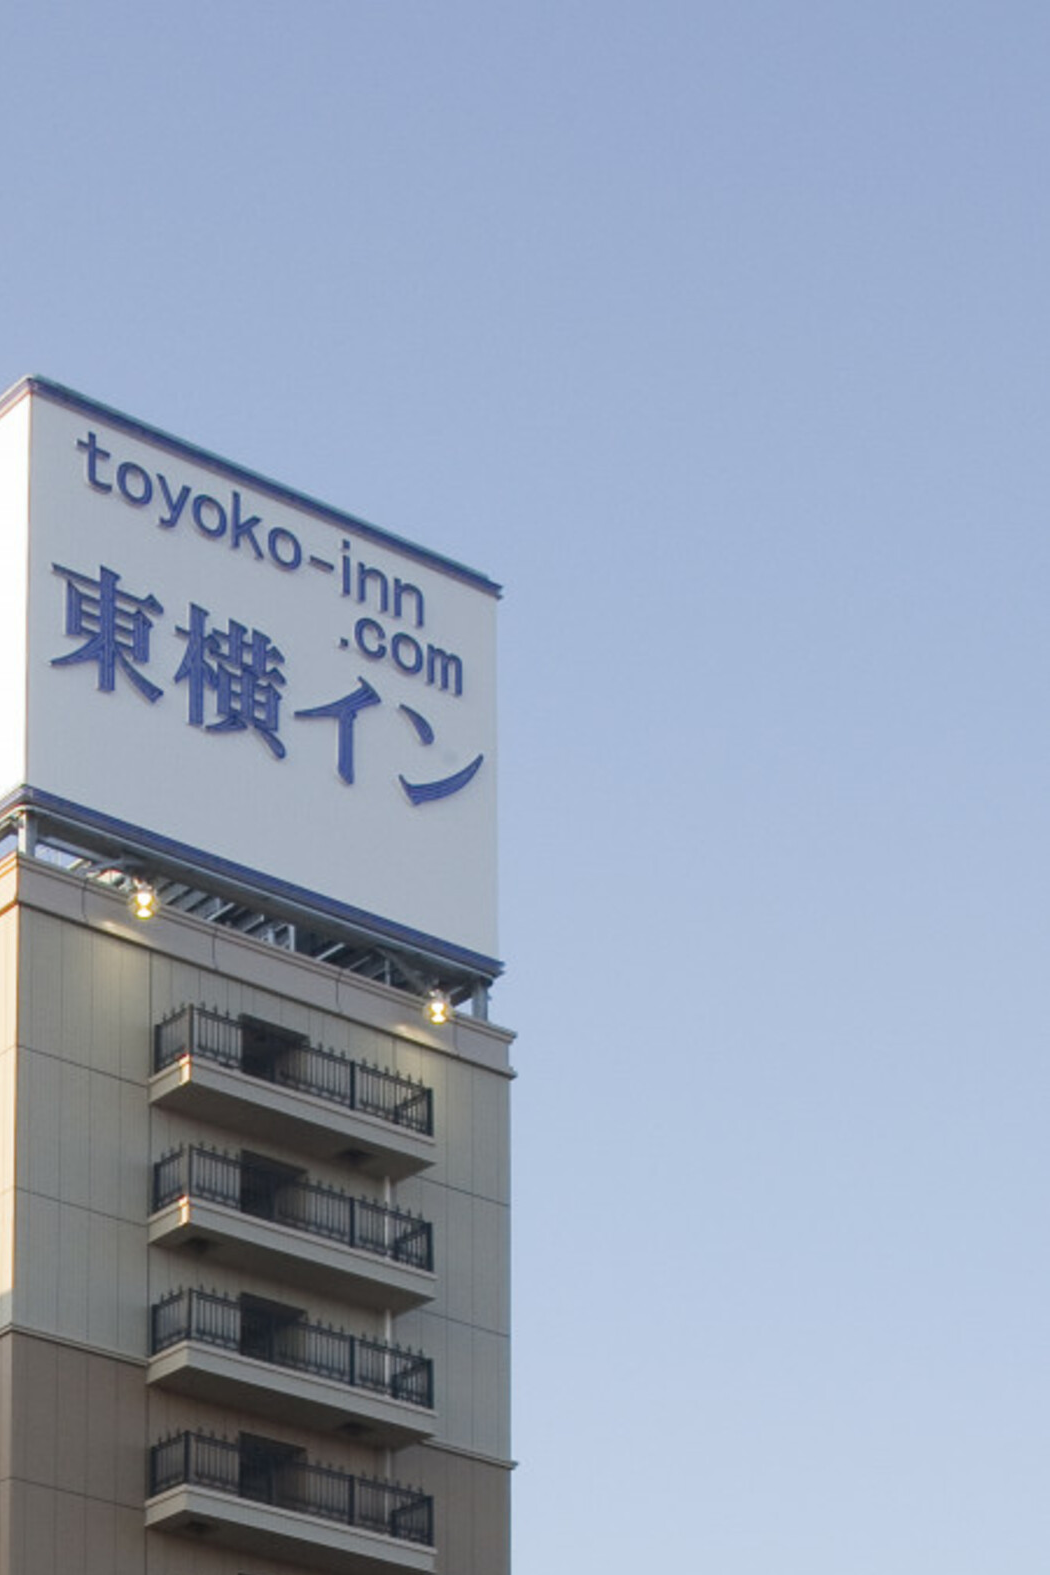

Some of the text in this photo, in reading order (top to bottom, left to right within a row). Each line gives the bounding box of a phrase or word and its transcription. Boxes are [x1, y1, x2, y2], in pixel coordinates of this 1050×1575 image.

[76, 431, 425, 628] toyoko-inn
[50, 562, 485, 806] 東横イン
[339, 616, 464, 697] .com
